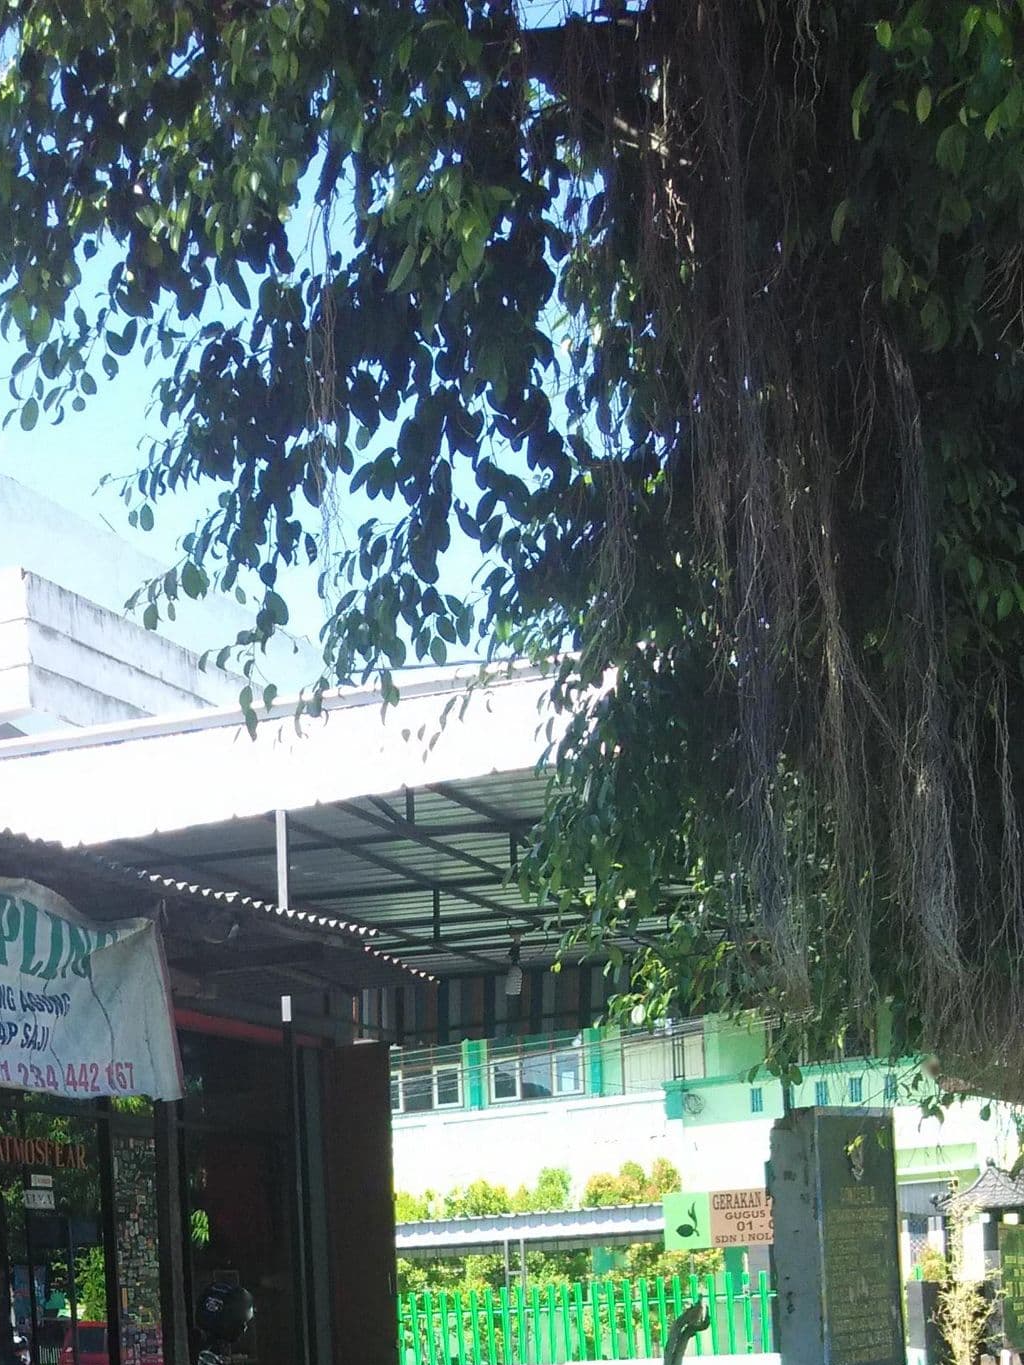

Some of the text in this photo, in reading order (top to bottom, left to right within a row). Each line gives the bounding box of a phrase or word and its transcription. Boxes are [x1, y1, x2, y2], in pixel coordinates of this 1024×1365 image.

[19, 989, 72, 1017] AGUNG
[20, 1023, 51, 1053] SAJI
[65, 1062, 101, 1092] 442
[711, 1191, 762, 1210] GERAKAN
[724, 1209, 766, 1221] GUGUS
[714, 1234, 738, 1244] SDN
